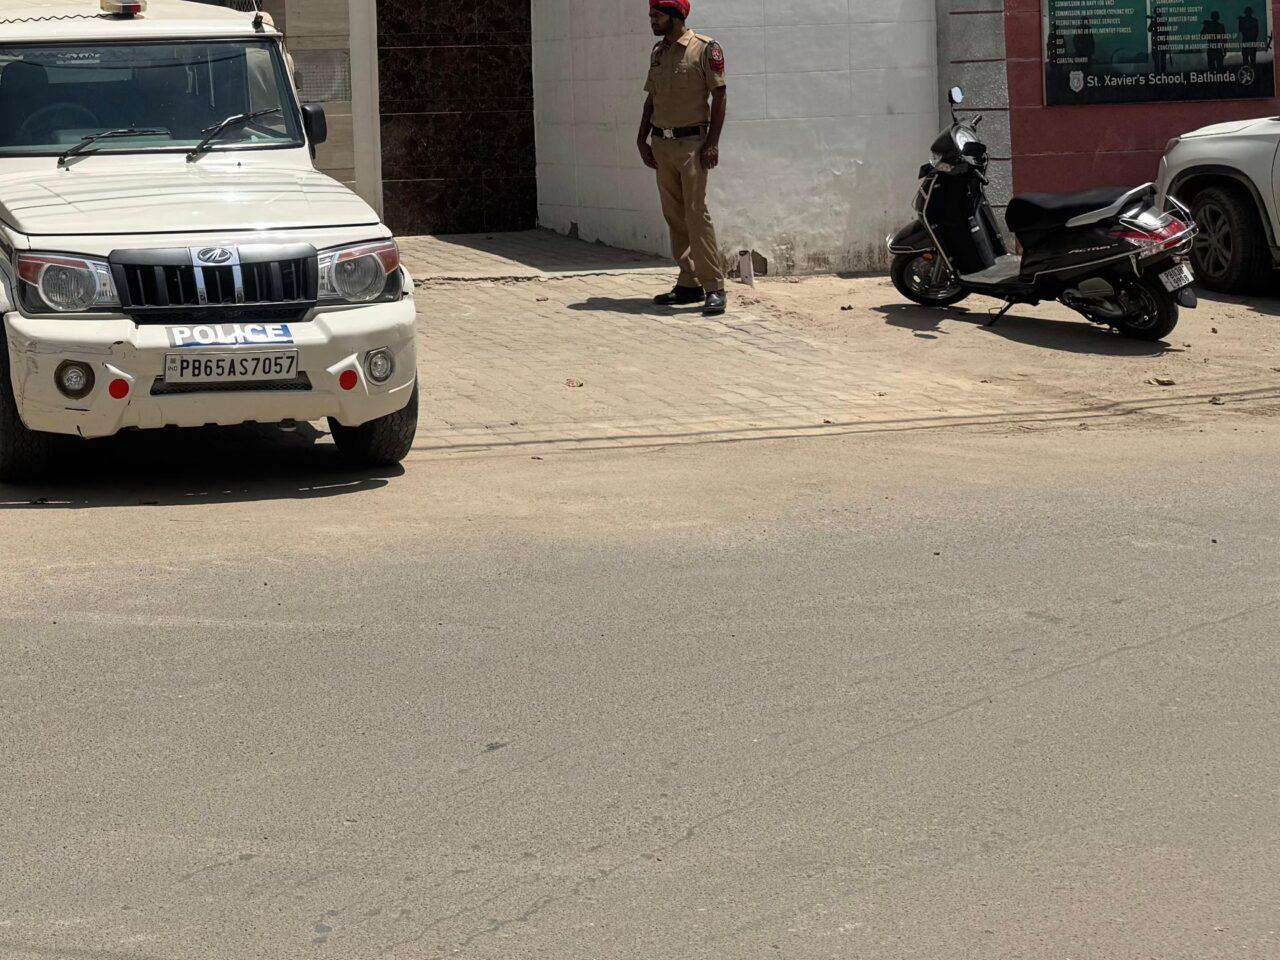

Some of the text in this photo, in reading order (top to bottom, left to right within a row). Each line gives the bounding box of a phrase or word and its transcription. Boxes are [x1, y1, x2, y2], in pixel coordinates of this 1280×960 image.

[1087, 71, 1236, 87] St. Xavier's School, Bathinda
[172, 323, 293, 346] POLICE
[179, 355, 295, 378] PB65AS7057
